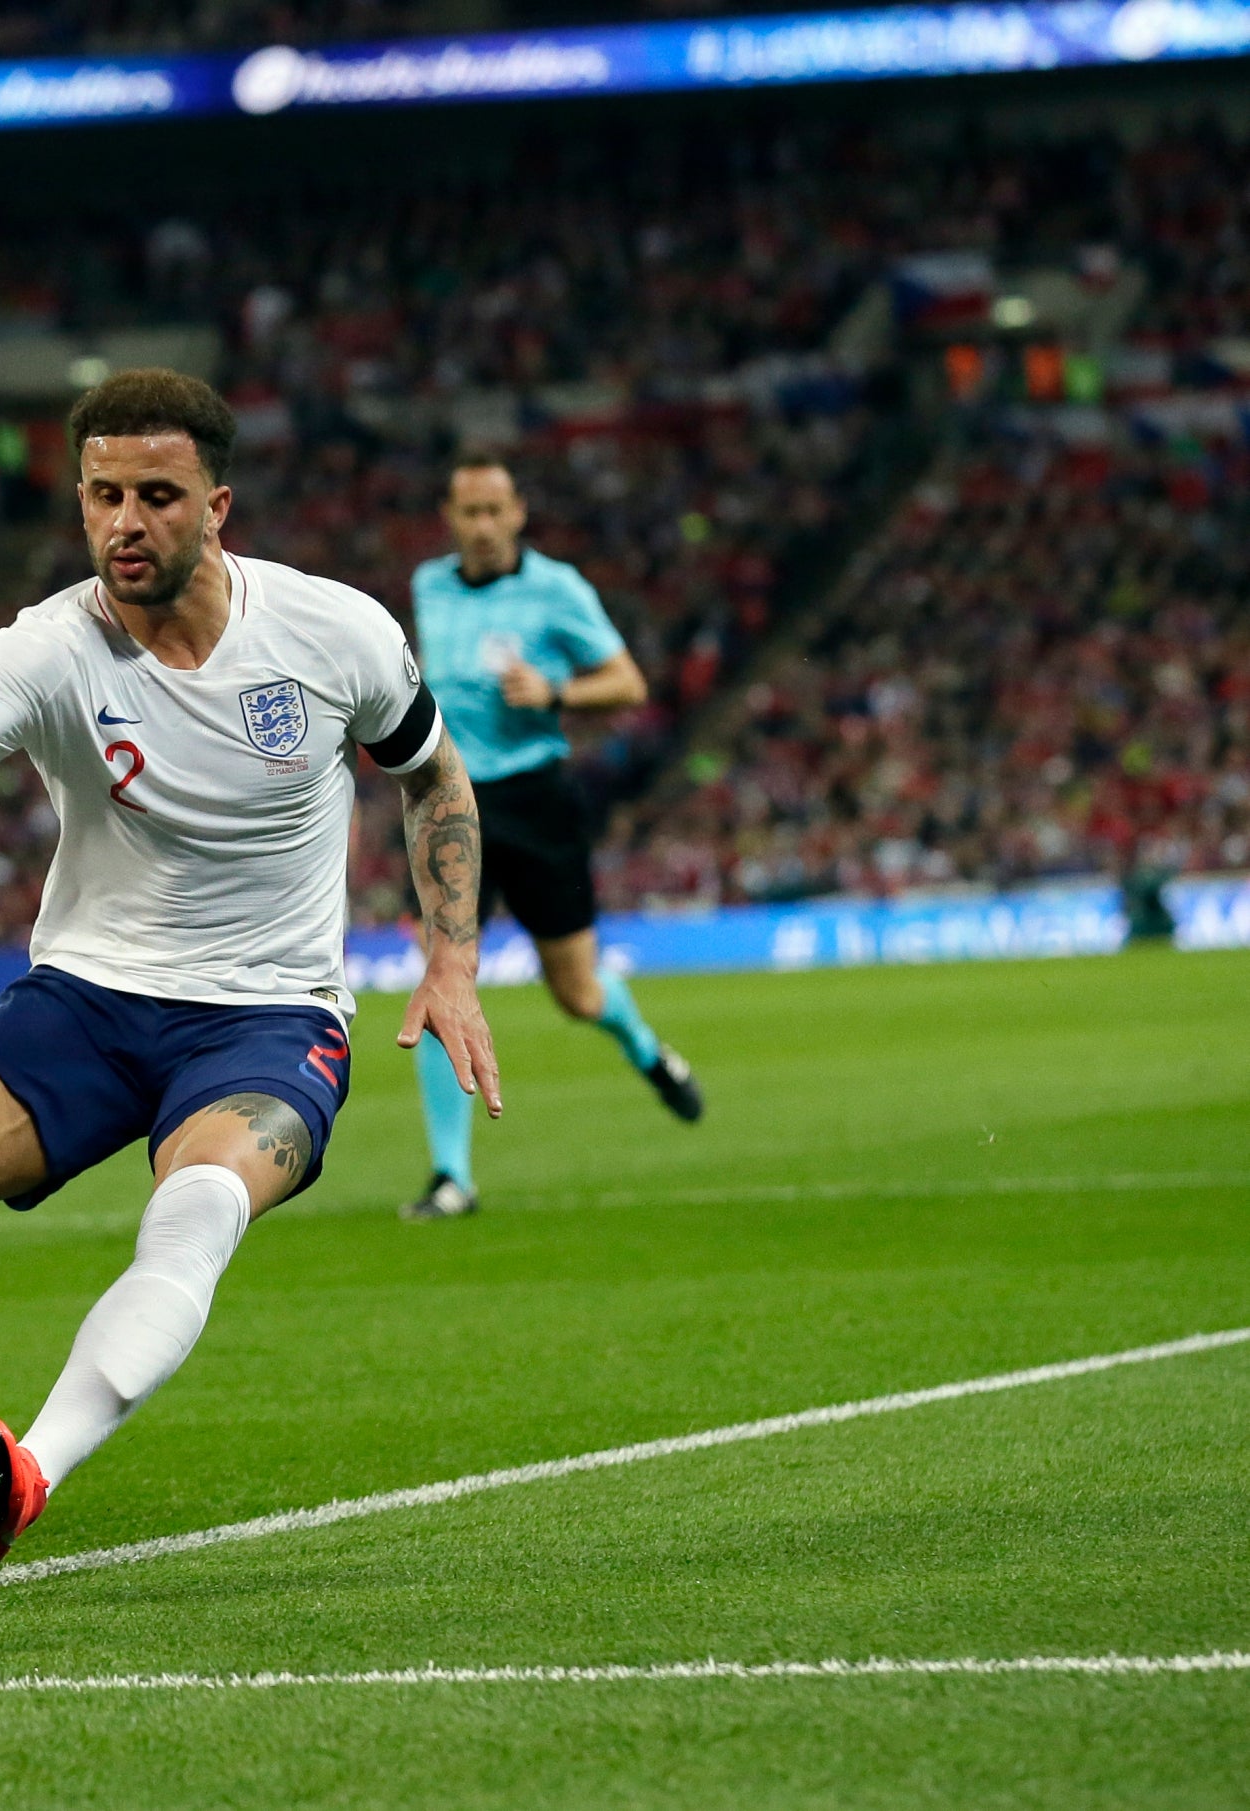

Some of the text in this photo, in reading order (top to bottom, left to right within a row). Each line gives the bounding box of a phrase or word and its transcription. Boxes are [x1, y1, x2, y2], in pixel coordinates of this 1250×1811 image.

[104, 740, 148, 814] 2
[266, 768, 275, 776] 22
[276, 766, 296, 775] MARCH
[307, 1028, 348, 1088] 2
